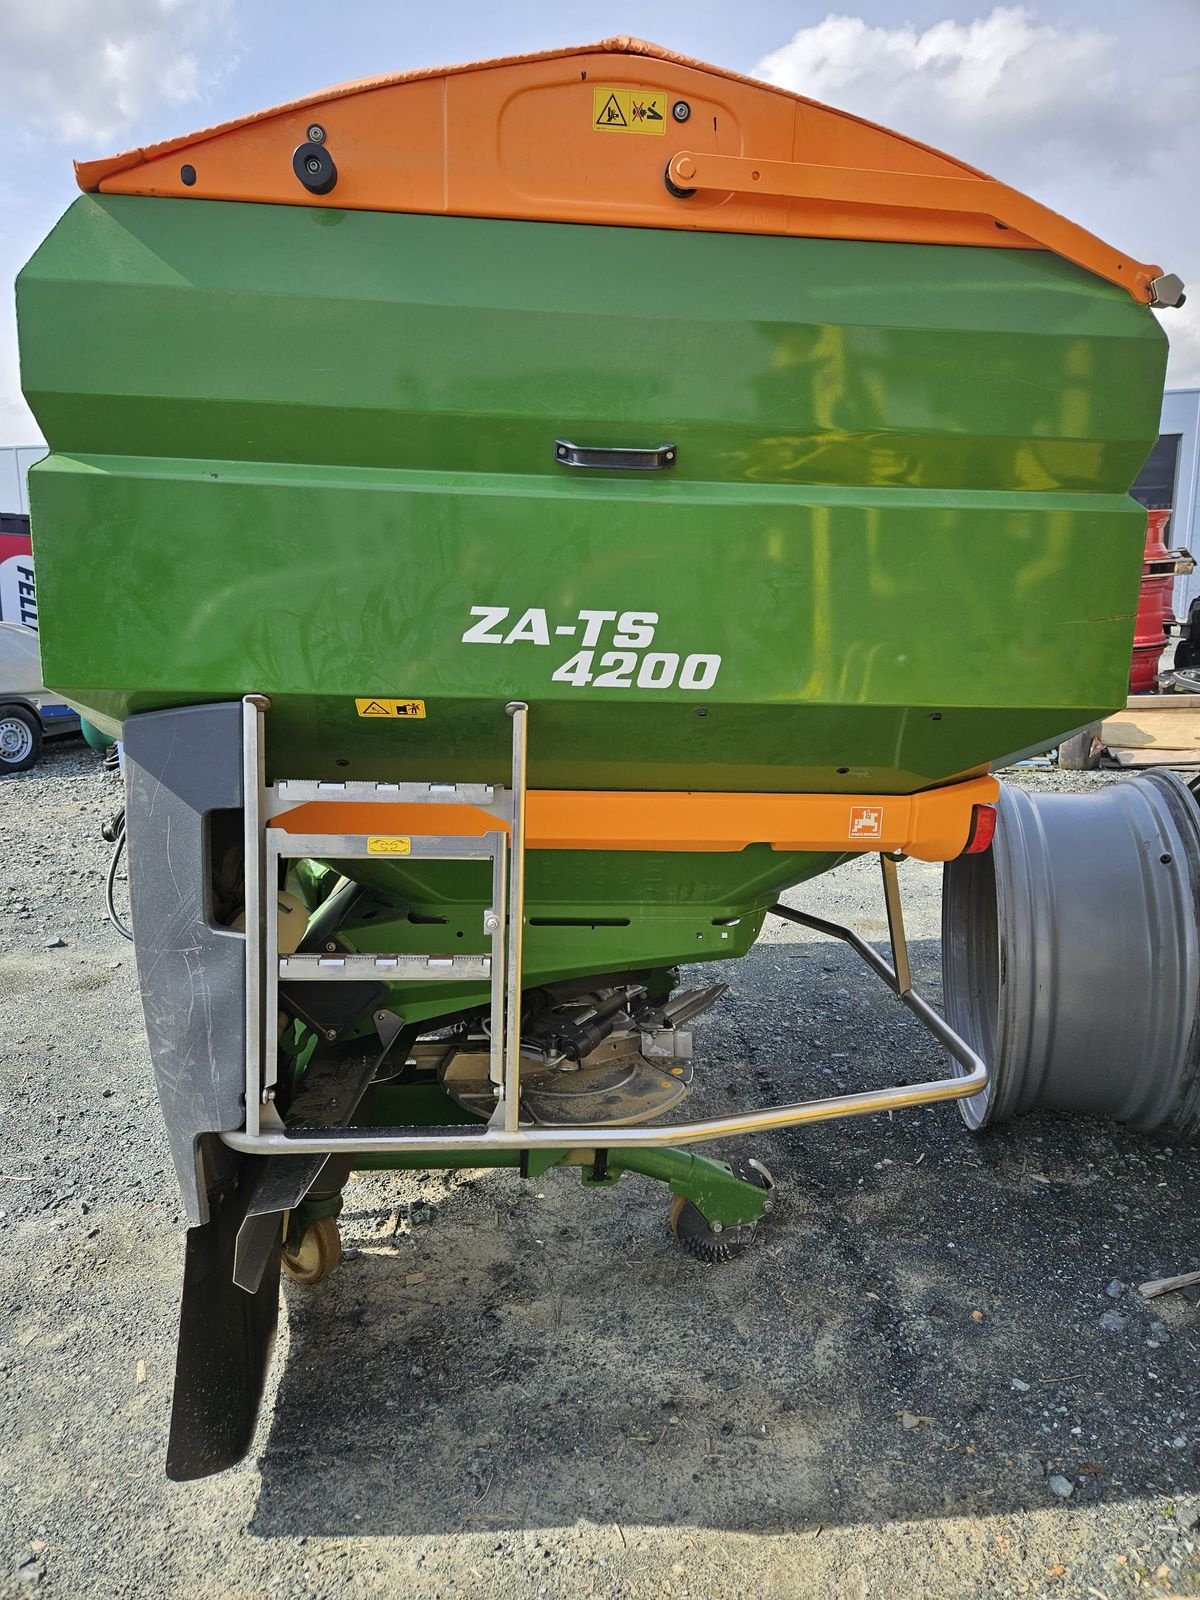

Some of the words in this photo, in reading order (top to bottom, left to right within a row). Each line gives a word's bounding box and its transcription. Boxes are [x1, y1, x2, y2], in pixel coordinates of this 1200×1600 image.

[17, 565, 38, 632] FELL
[461, 605, 659, 648] ZA-TS
[551, 650, 722, 690] 4200
